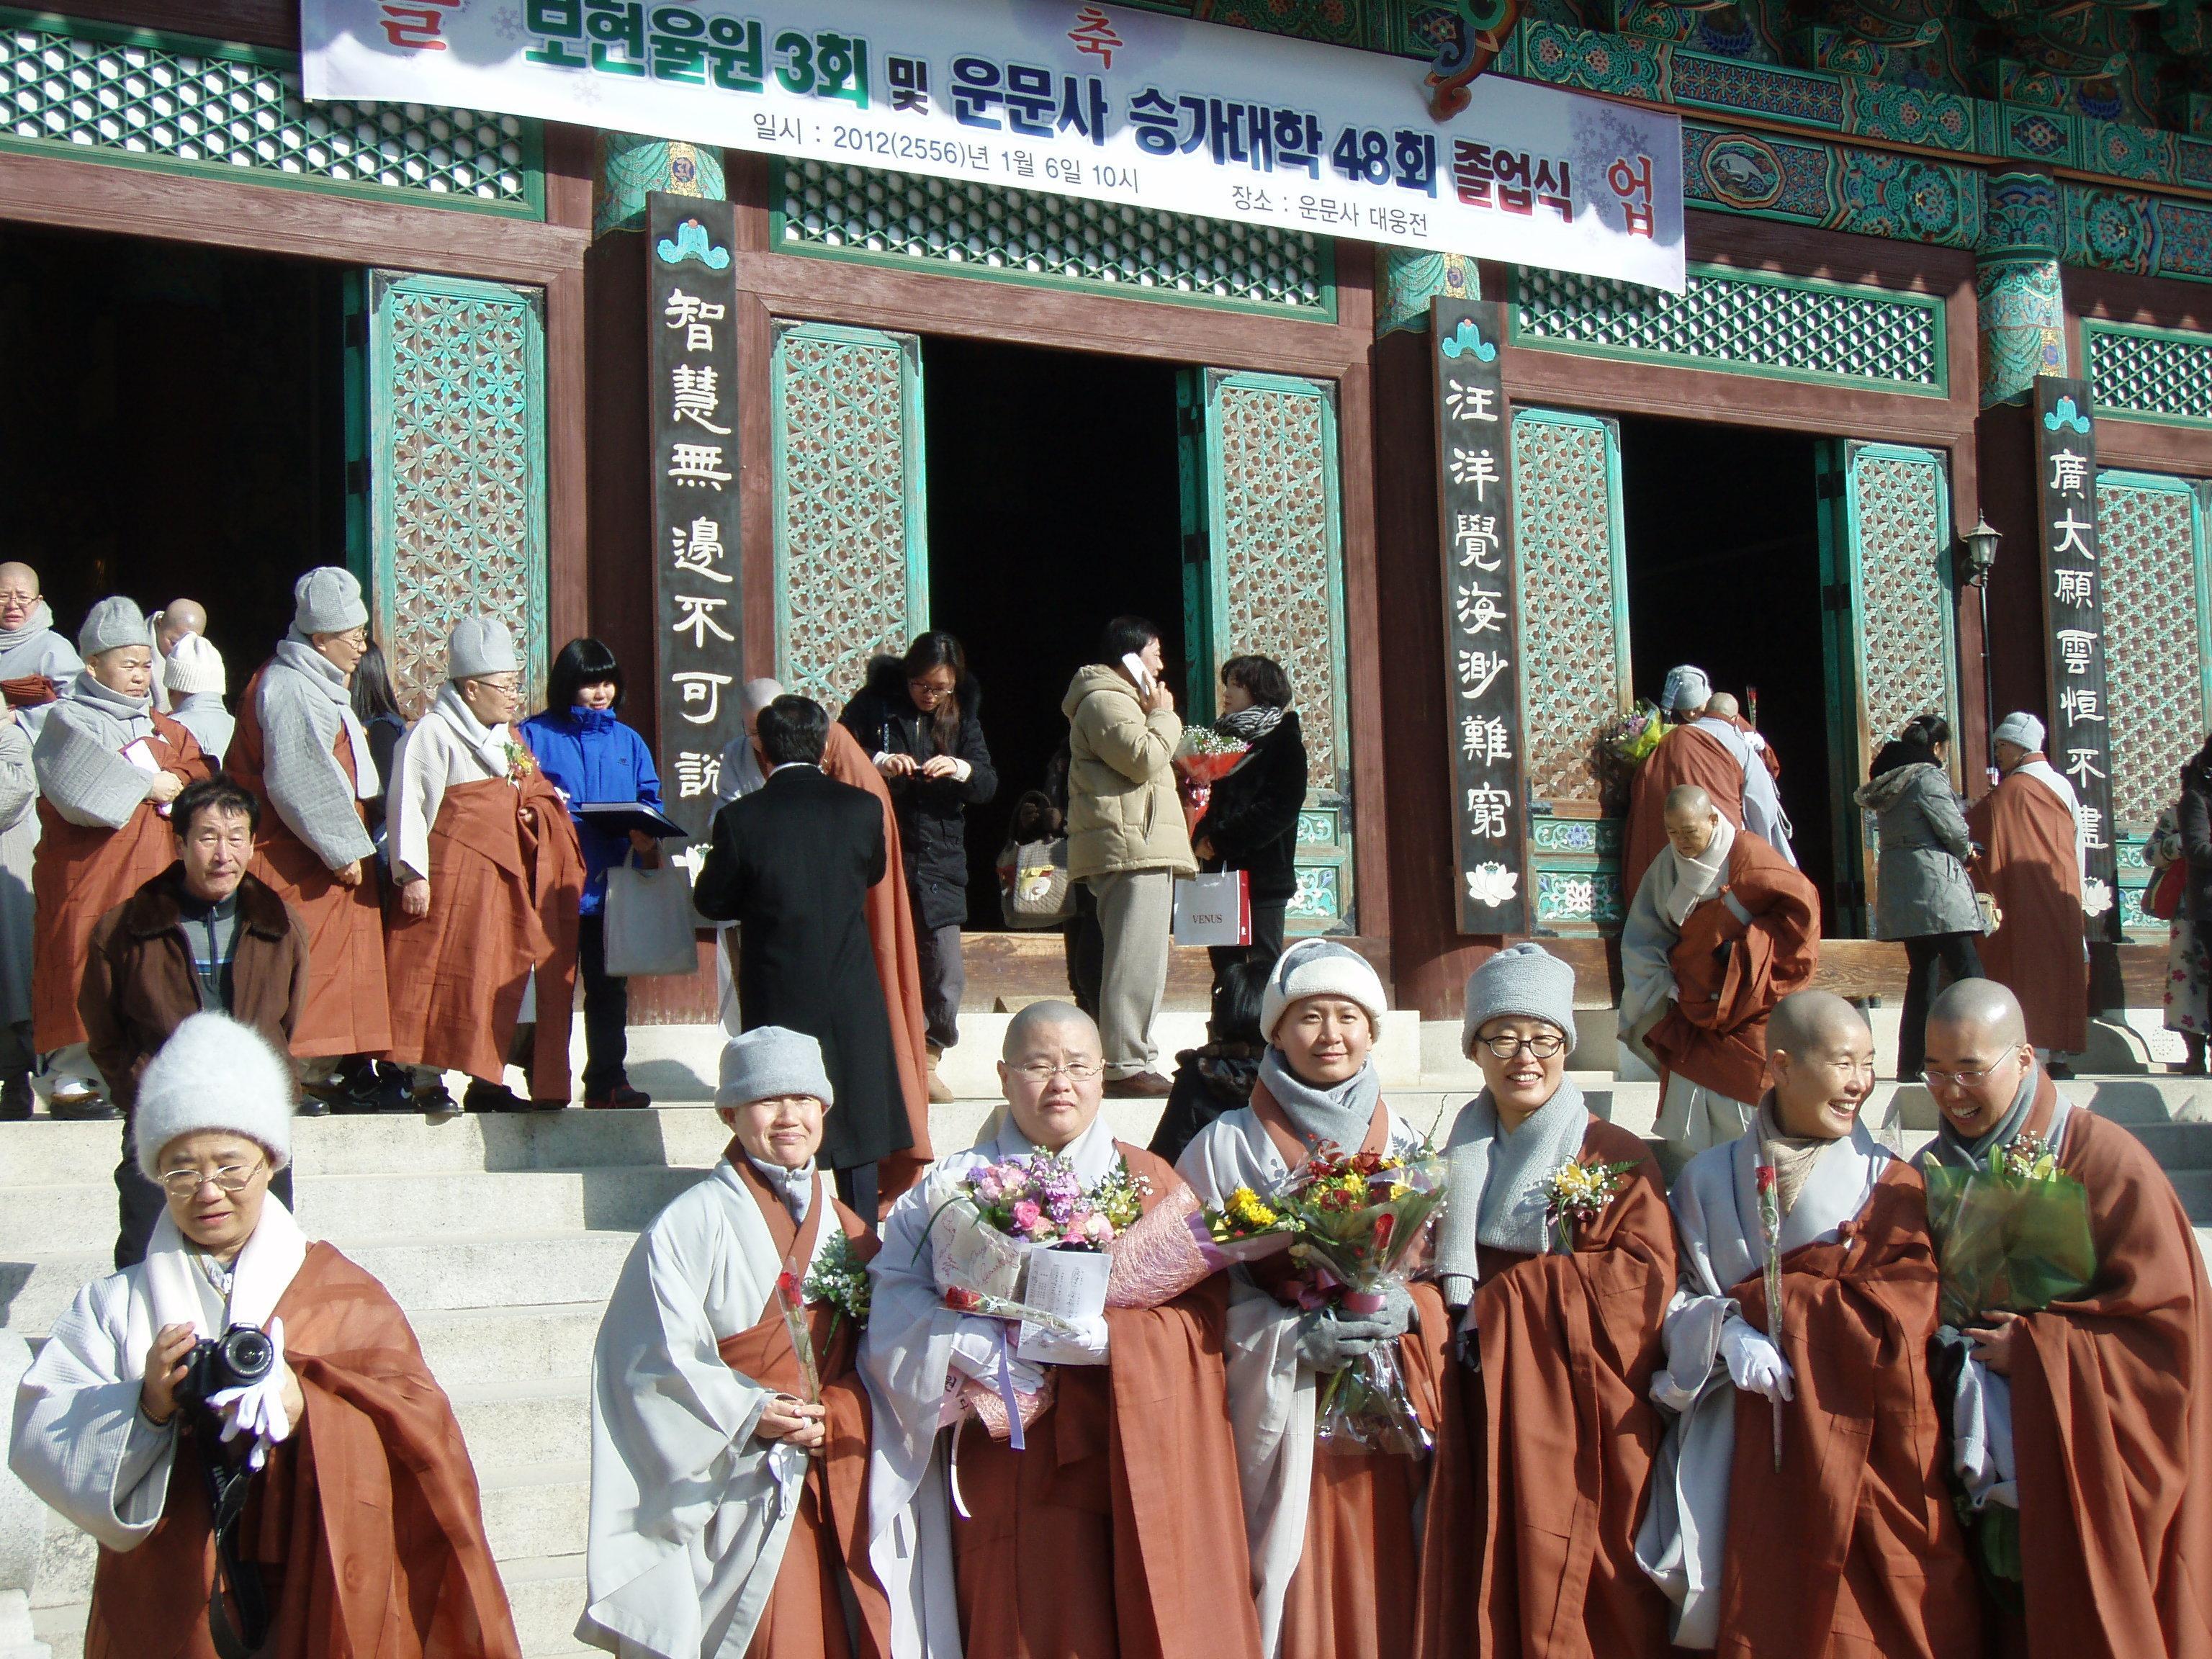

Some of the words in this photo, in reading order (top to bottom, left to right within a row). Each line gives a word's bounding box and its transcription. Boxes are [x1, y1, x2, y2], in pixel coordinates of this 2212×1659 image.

[1068, 6, 1123, 70] 축
[753, 113, 801, 145] 일시
[833, 125, 989, 171] 2012(2556)년
[1002, 150, 1033, 178] 1월
[1046, 156, 1082, 184] 6일
[1092, 163, 1138, 194] 10시
[888, 56, 929, 116] 및
[950, 58, 1108, 146] 운문사
[1130, 88, 1323, 180] 승가대학
[1333, 128, 1438, 199] 48회
[1453, 139, 1573, 223] 졸업식
[1231, 185, 1273, 212] 장소
[1298, 194, 1359, 227] 운문사
[1370, 205, 1427, 238] 대웅전
[1607, 155, 1654, 239] 업
[1192, 914, 1223, 924] VENUS
